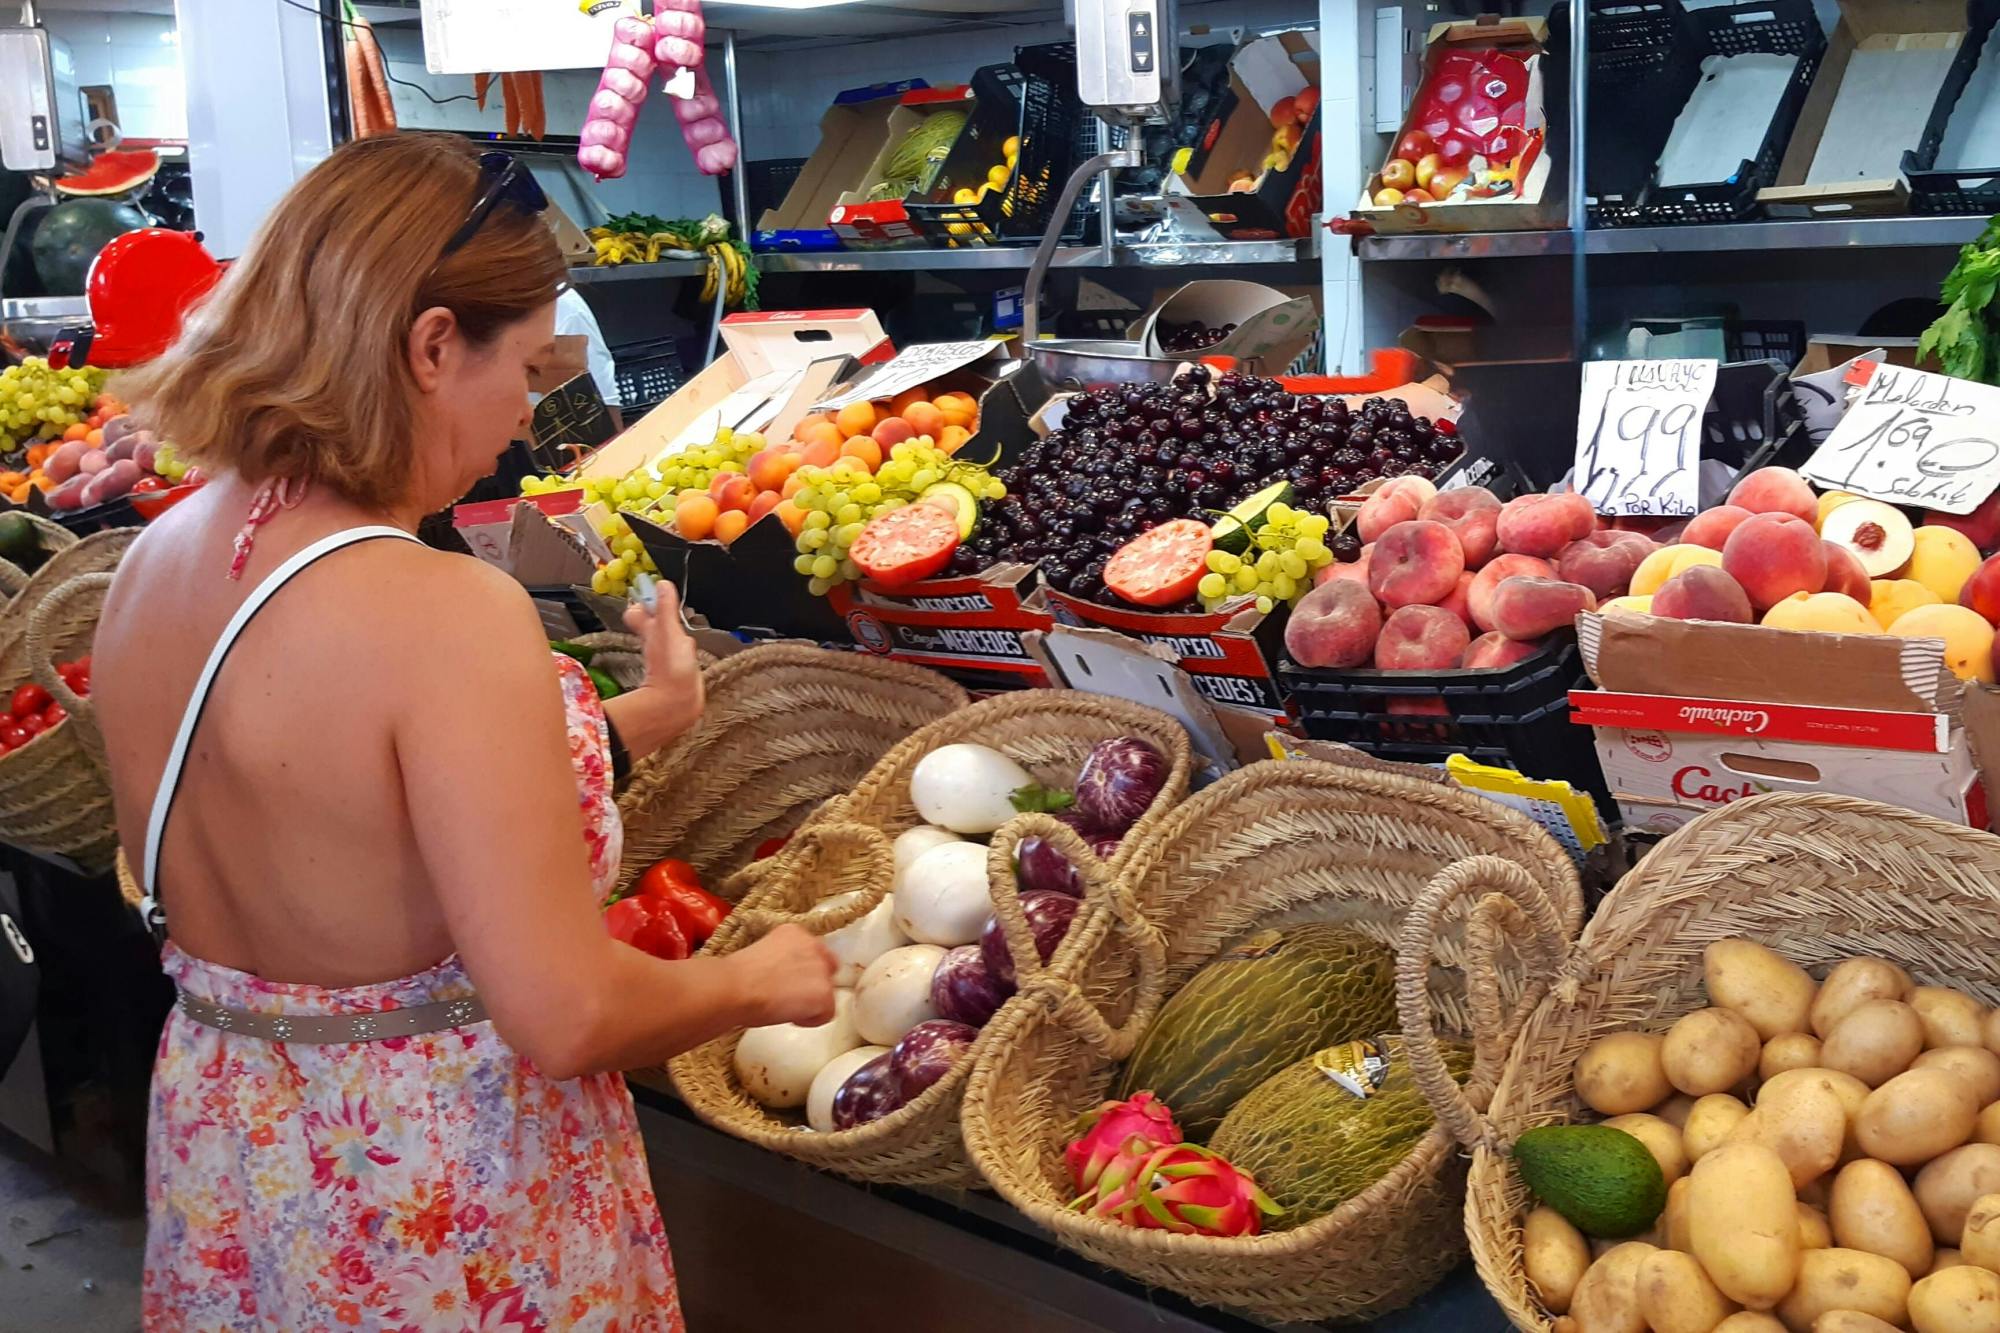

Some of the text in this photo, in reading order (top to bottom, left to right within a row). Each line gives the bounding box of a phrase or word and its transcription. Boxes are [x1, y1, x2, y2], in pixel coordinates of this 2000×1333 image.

[1624, 493, 1654, 514] POR
[937, 629, 1023, 655] MERCEDES
[1192, 675, 1256, 703] CEDES
[1679, 706, 1769, 733] Cachirulo
[1671, 766, 1760, 805] Cach
